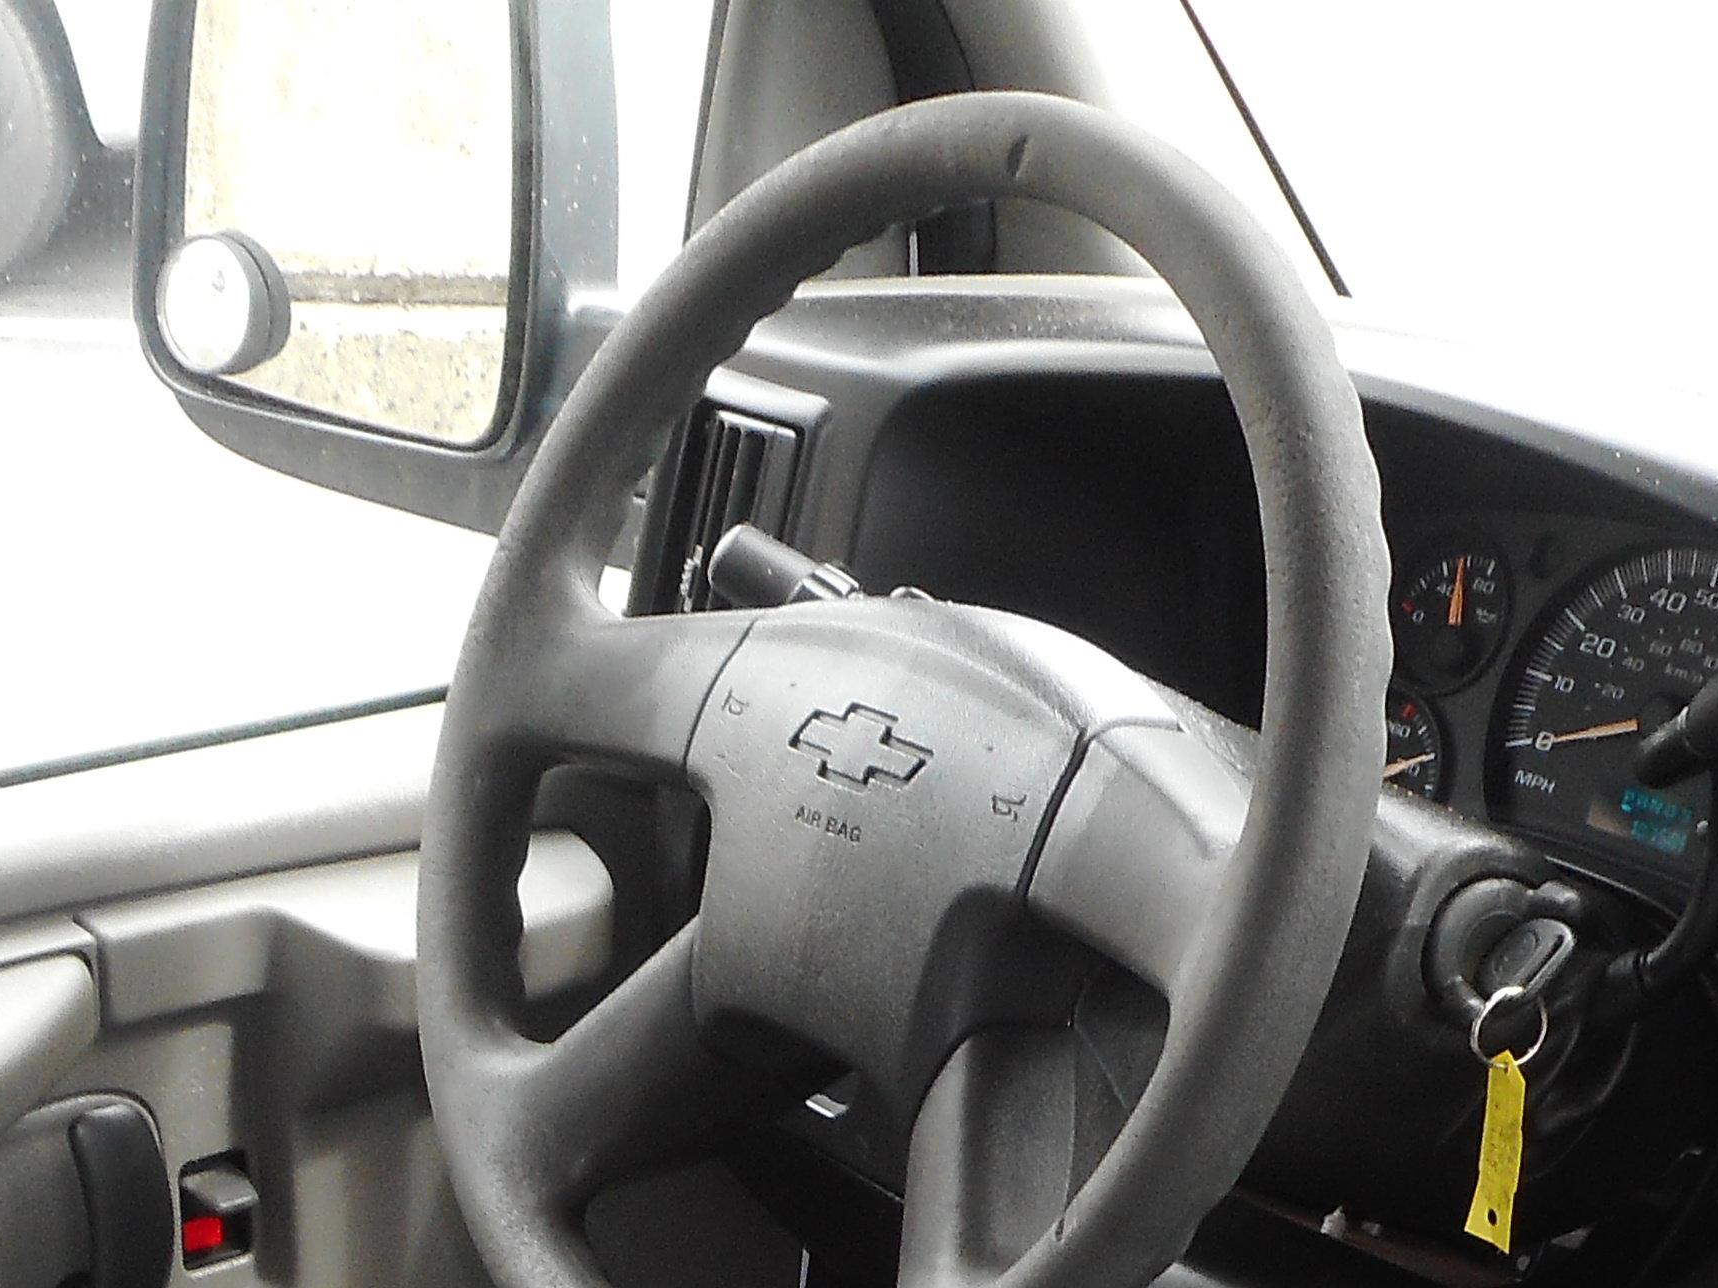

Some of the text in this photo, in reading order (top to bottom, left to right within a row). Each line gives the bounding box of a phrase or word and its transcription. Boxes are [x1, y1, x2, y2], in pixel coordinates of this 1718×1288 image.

[1650, 588, 1687, 613] 40
[1617, 604, 1645, 624] 30
[1580, 633, 1616, 658] 20
[1554, 675, 1574, 693] 10
[1535, 731, 1554, 752] 0
[1515, 770, 1555, 794] MPH
[794, 804, 862, 842] AIR BAG
